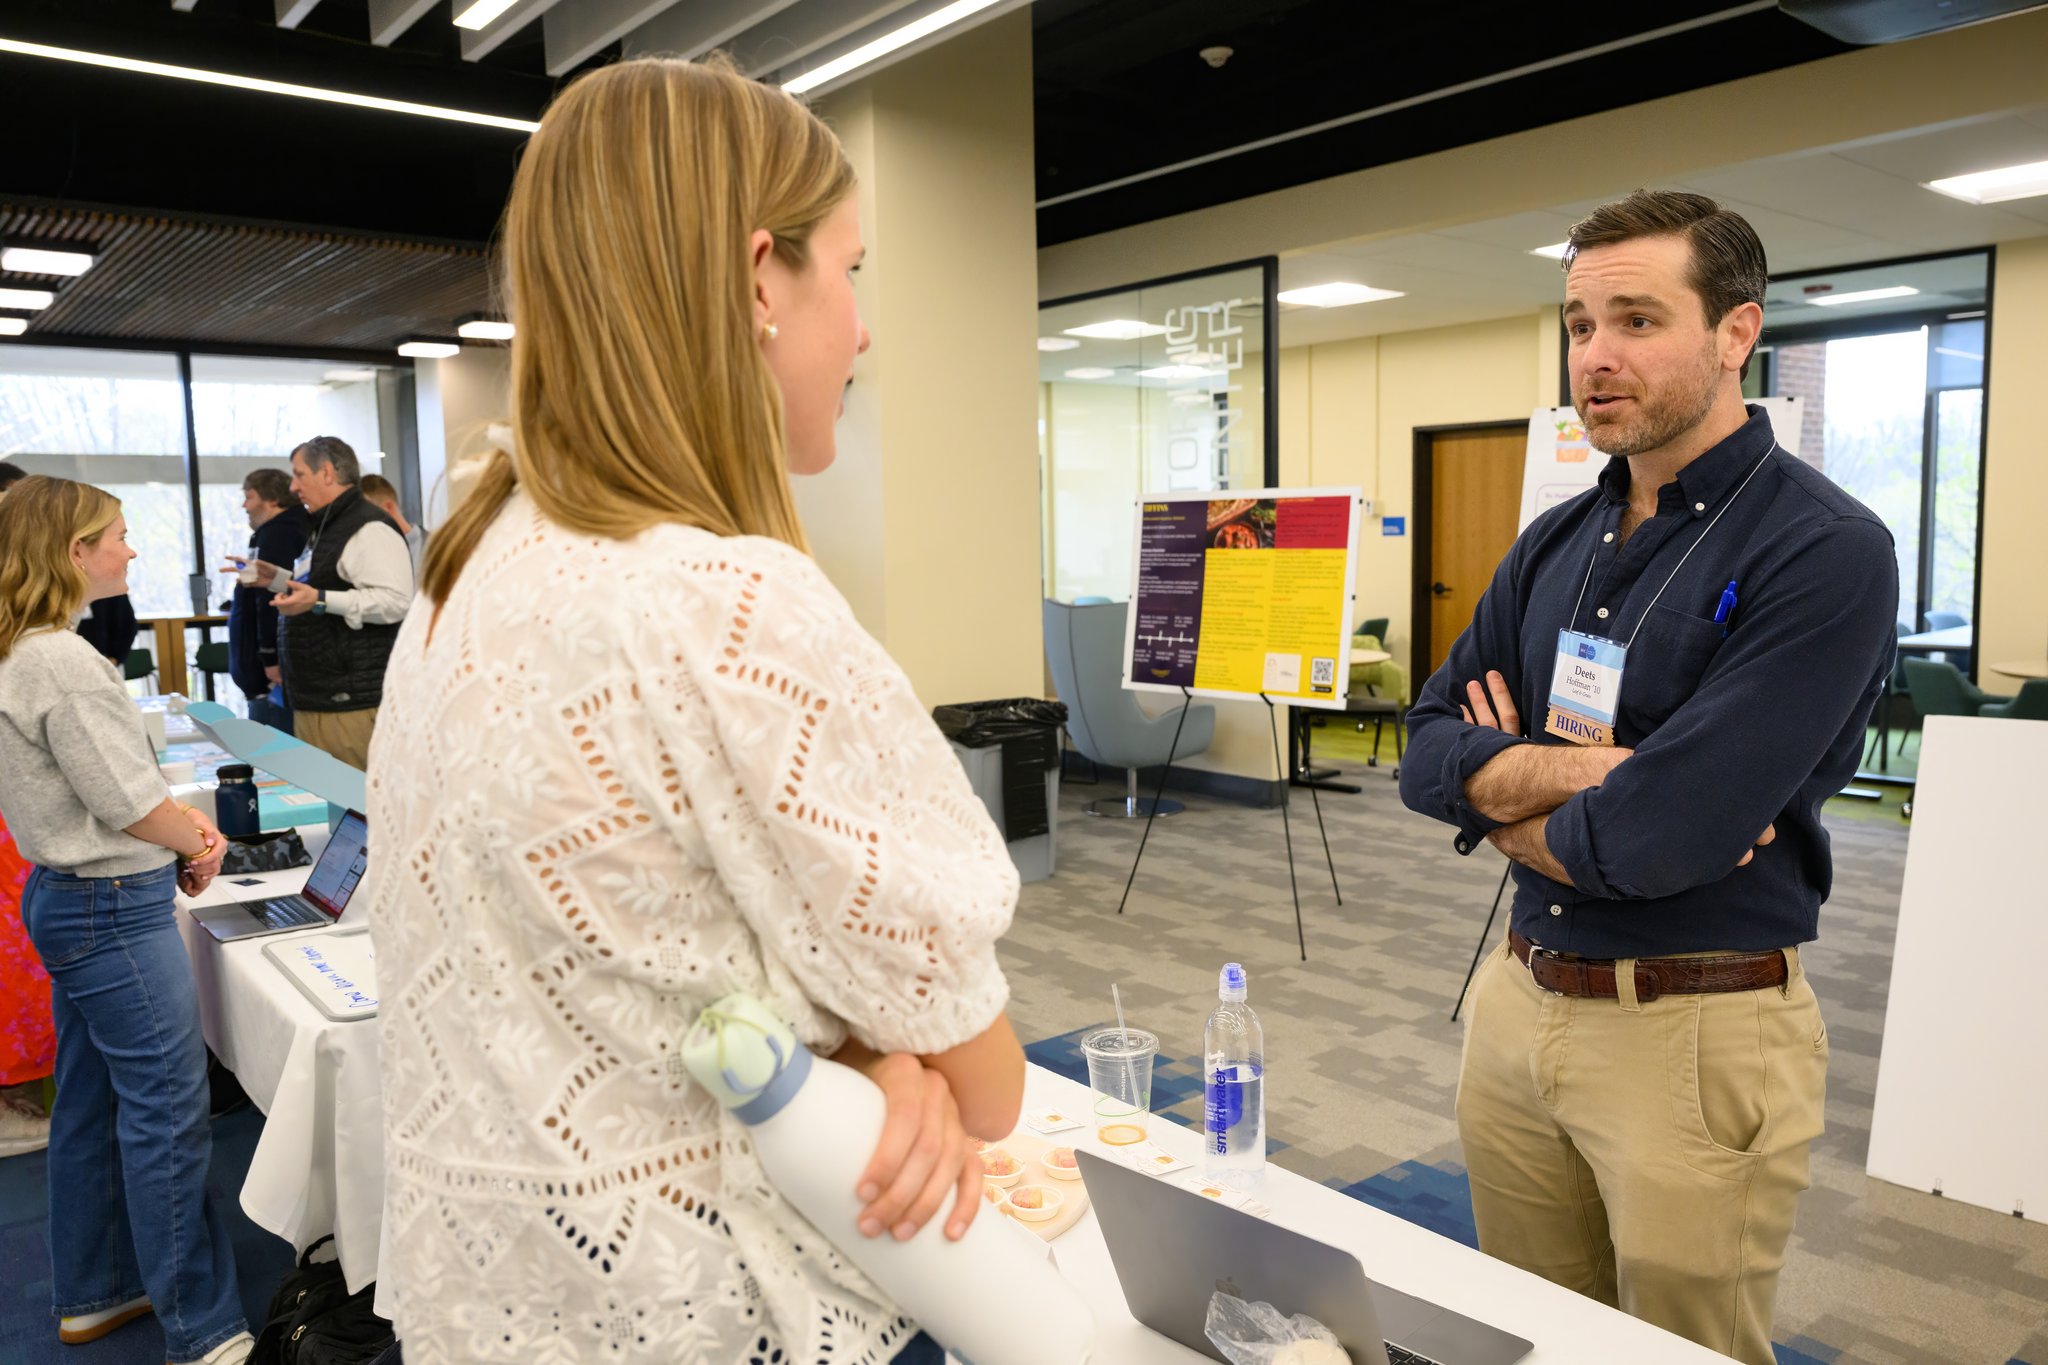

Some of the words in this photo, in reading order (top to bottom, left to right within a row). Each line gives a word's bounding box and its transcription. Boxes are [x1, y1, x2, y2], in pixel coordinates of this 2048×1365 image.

[1208, 298, 1243, 491] ENTER
[1574, 665, 1596, 681] Deets
[1555, 714, 1603, 742] HIRING
[1214, 1067, 1227, 1154] smartwater
